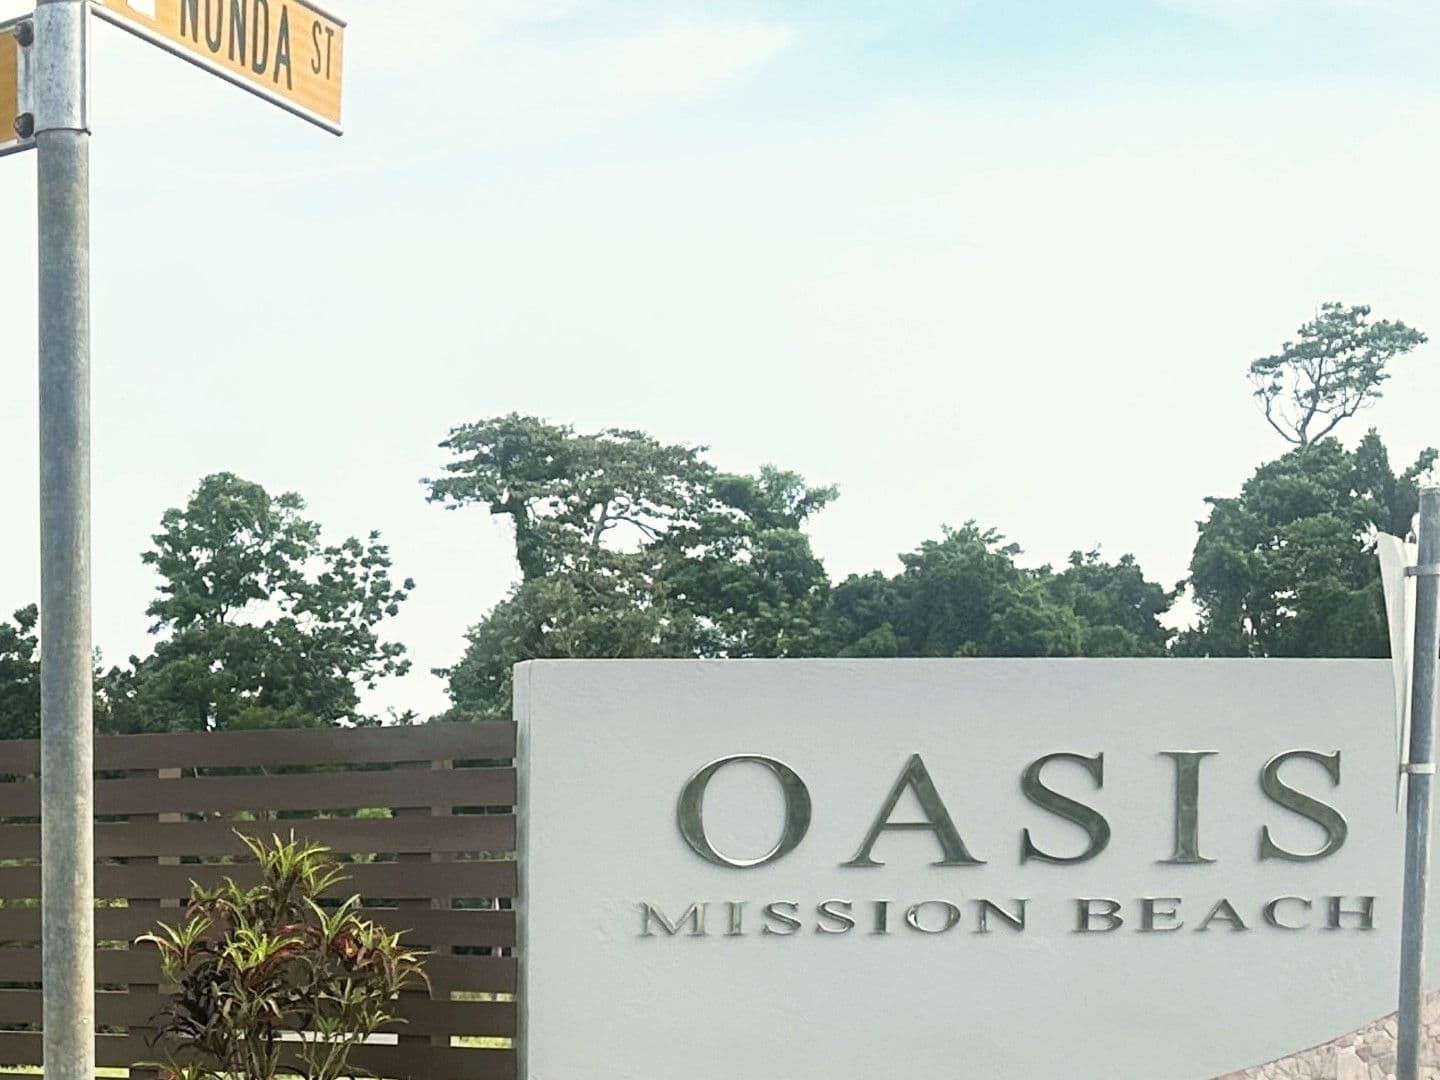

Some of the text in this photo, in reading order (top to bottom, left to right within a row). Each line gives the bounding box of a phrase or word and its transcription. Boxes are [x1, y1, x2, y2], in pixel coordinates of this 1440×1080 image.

[311, 20, 334, 81] ST
[677, 748, 1349, 870] OASIS
[635, 896, 1379, 938] MISSION BEACH
